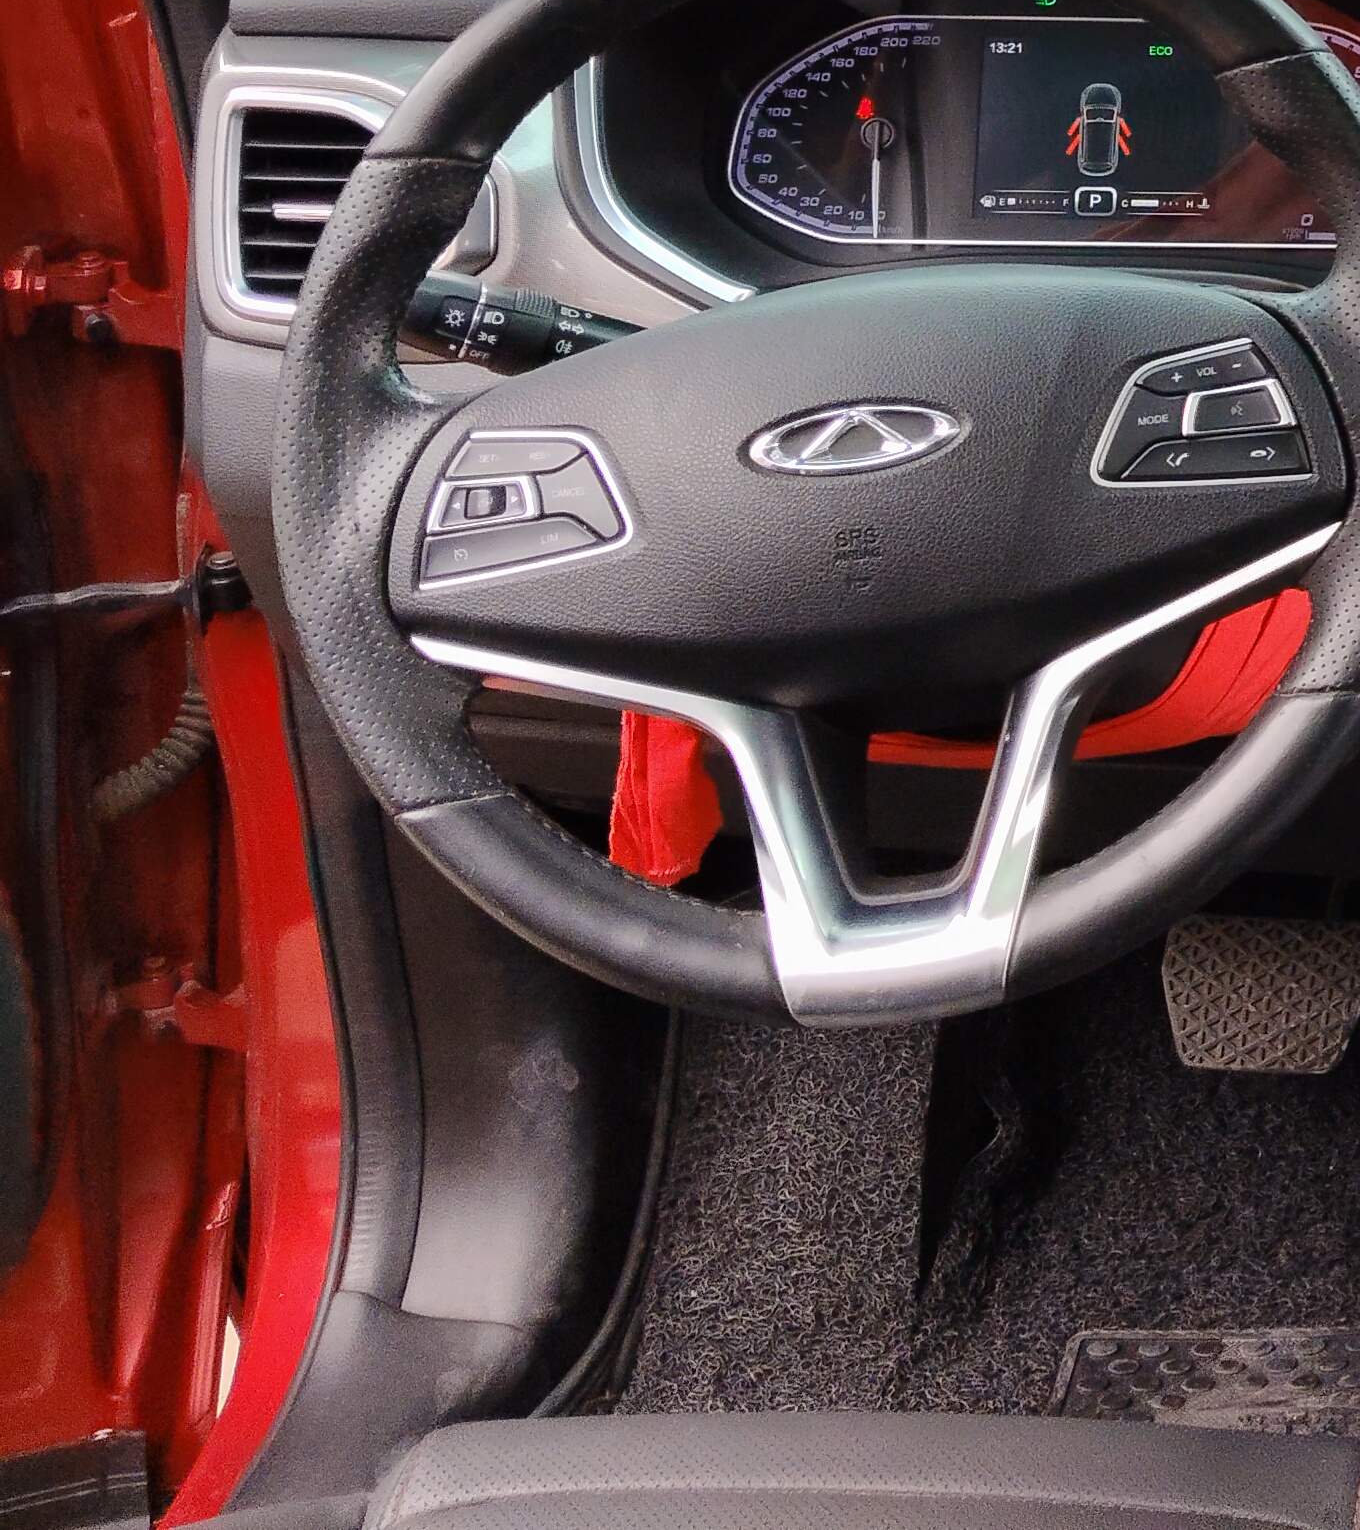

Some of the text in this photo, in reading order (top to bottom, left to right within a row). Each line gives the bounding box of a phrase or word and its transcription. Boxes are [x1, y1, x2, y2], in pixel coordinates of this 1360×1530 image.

[880, 38, 908, 47] 200
[912, 36, 941, 46] 220
[853, 46, 878, 56] 180
[989, 42, 1023, 54] 13:21
[1149, 46, 1173, 56] ECO
[829, 58, 855, 68] 160
[805, 72, 831, 82] 140
[782, 88, 807, 98] 120
[767, 107, 791, 117] 100
[758, 129, 777, 138] 80
[753, 154, 772, 163] 60
[758, 173, 778, 183] 50
[778, 187, 798, 196] 40
[800, 197, 820, 206] 30
[1089, 195, 1102, 208] P
[1186, 200, 1194, 208] H
[823, 205, 843, 214] 20
[847, 210, 864, 220] 10
[1301, 214, 1314, 227] 0
[1196, 366, 1218, 377] VOL
[1137, 414, 1169, 426] MODE
[551, 487, 586, 498] CANCEL
